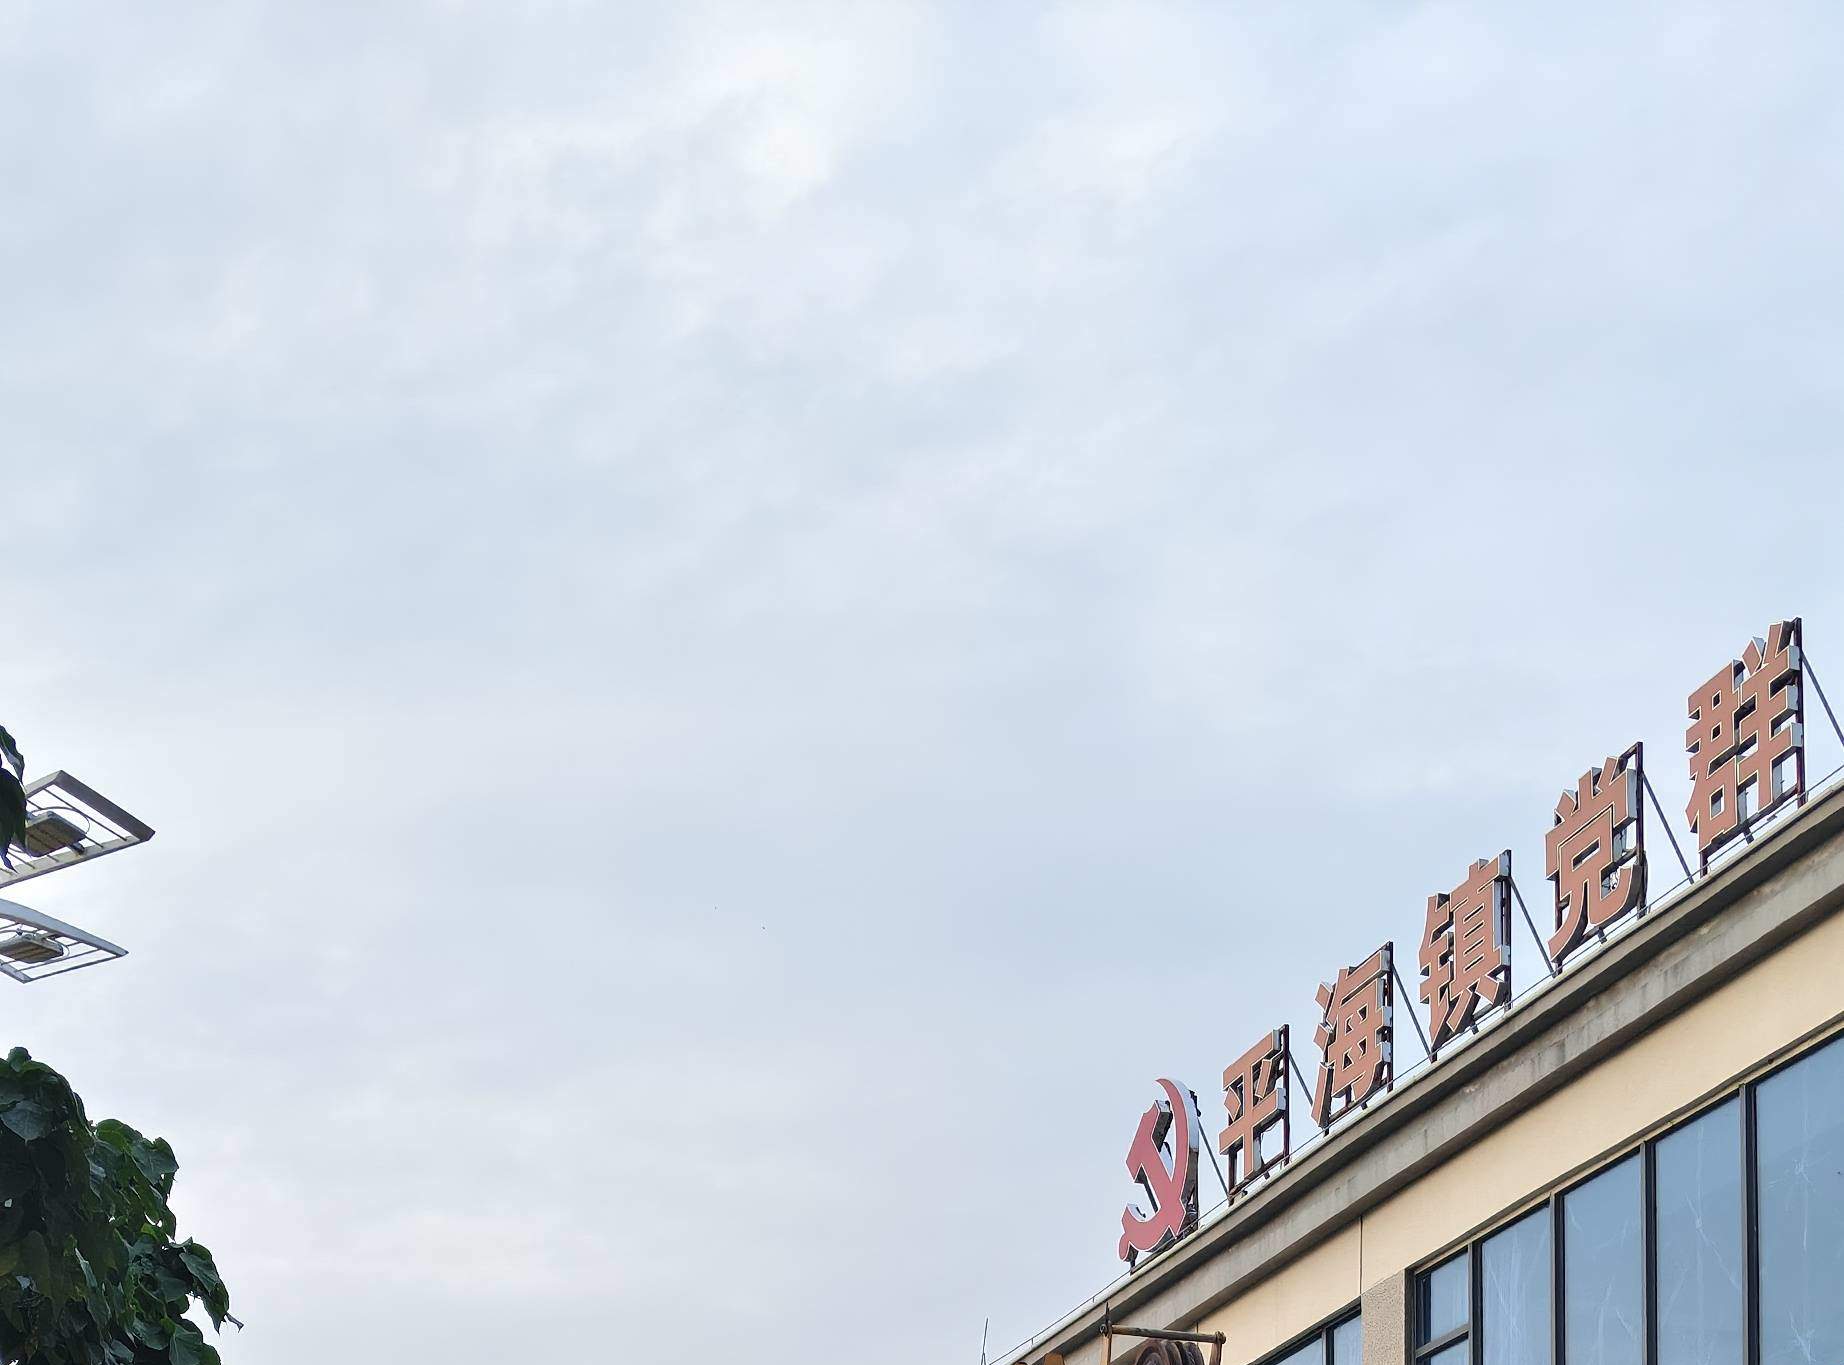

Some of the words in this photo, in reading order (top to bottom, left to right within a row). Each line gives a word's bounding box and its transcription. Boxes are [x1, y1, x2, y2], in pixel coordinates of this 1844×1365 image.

[1219, 618, 1803, 1180] 平海镇党群
